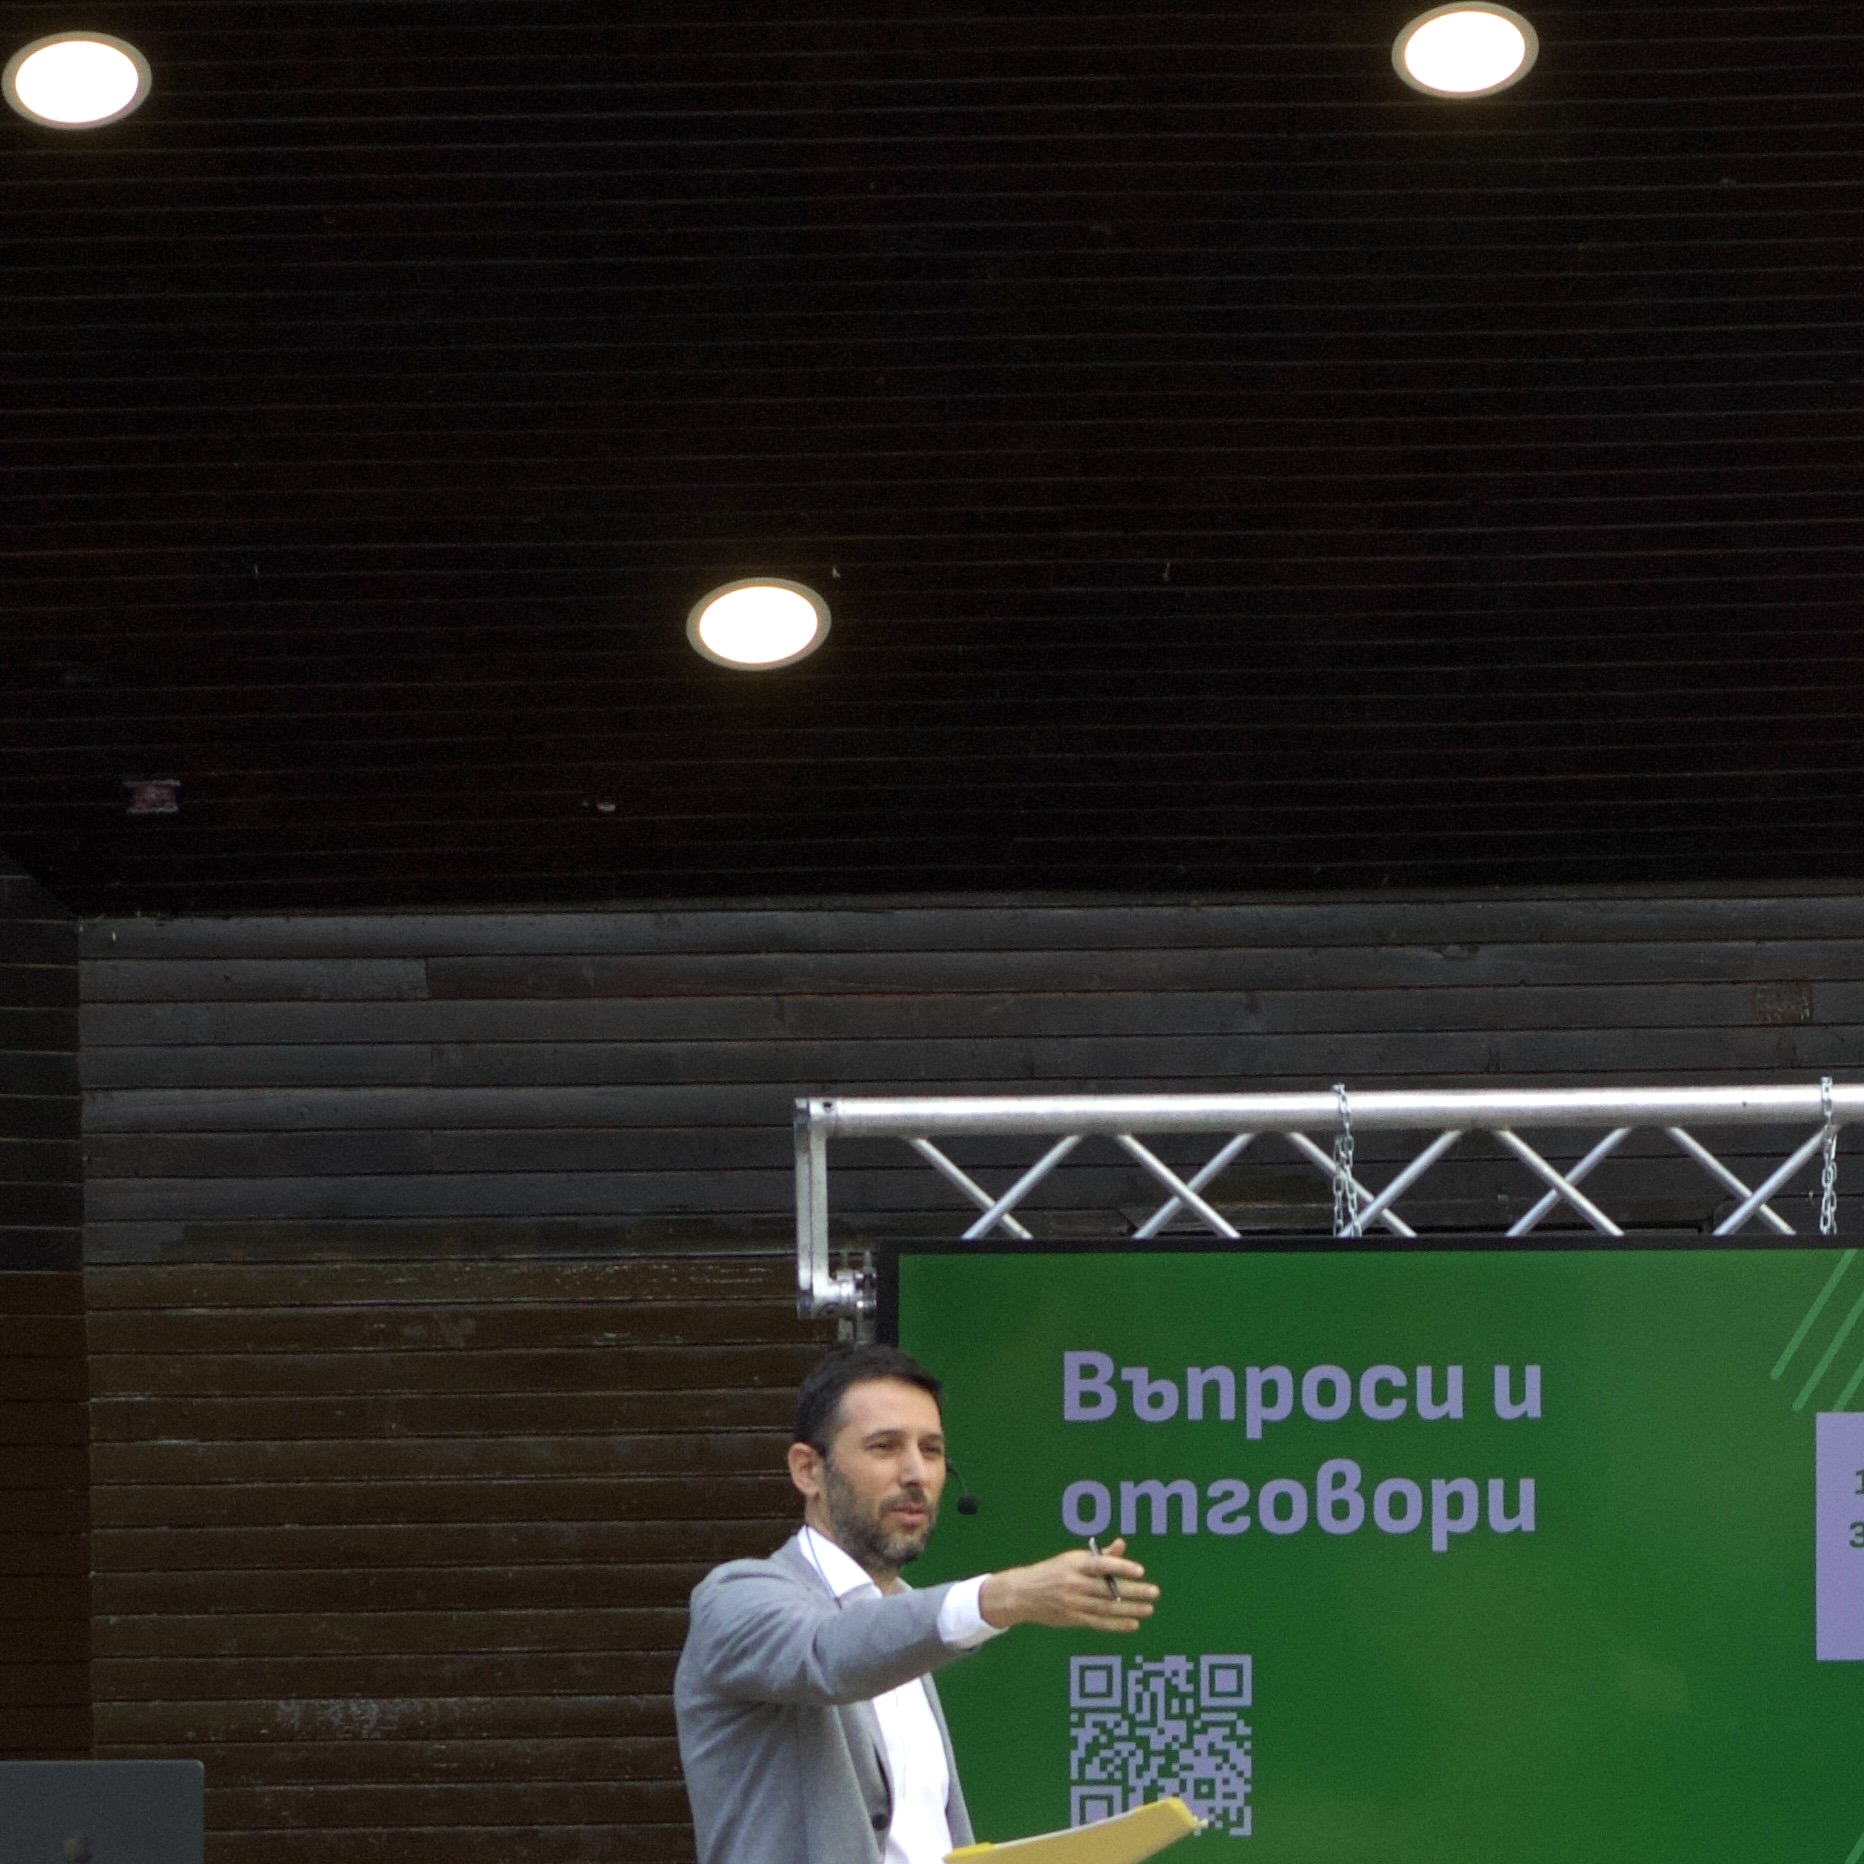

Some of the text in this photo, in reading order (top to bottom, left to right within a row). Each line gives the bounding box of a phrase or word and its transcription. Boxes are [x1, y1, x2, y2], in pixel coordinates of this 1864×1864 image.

[1064, 1351, 1541, 1440] Въпроси и
[1060, 1458, 1535, 1553] отговори
